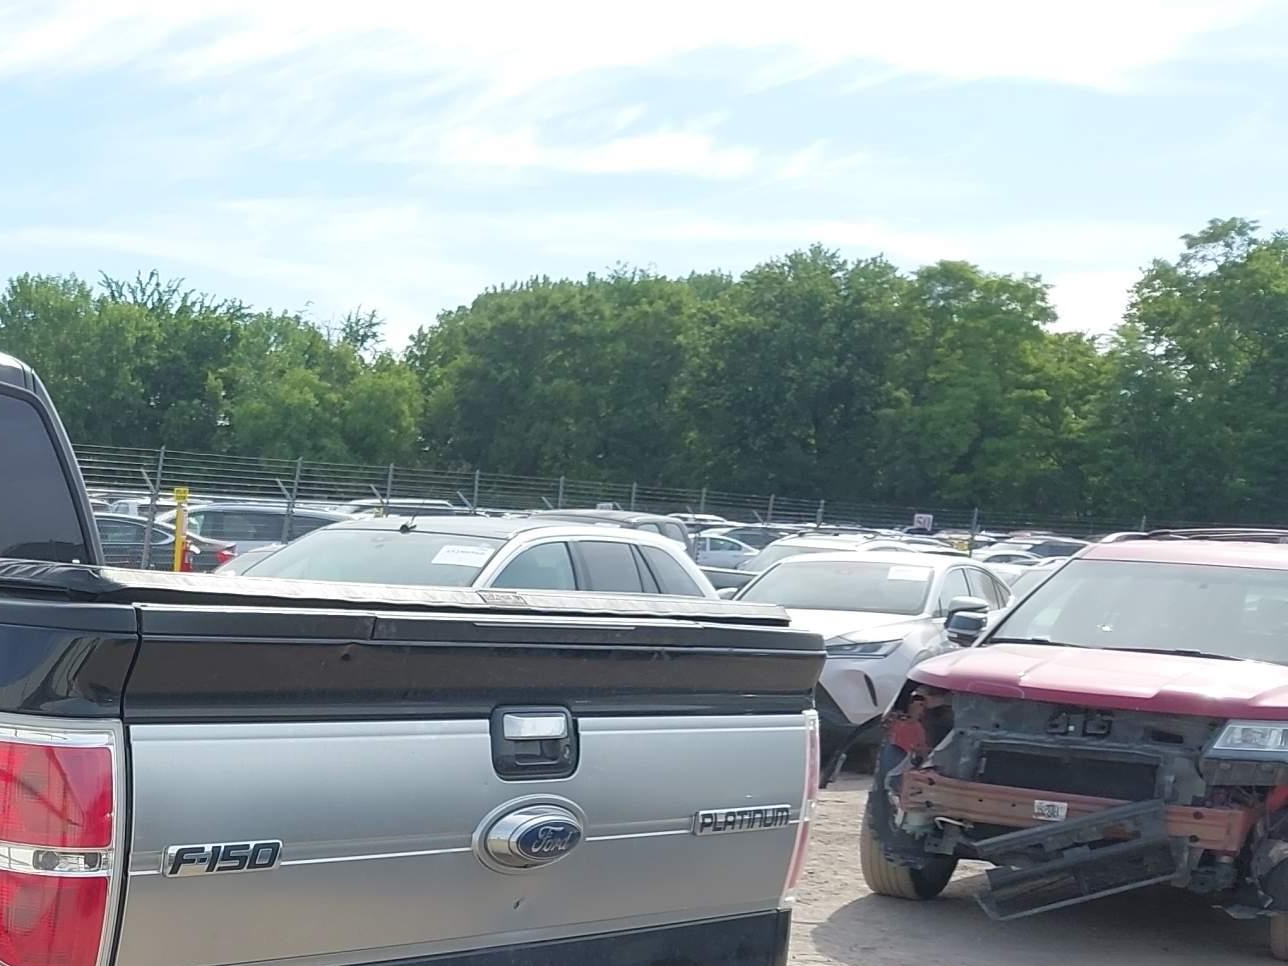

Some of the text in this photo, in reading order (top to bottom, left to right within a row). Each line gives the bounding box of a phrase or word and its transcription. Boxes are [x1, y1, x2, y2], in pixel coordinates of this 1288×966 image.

[699, 807, 790, 833] PLATINUM
[531, 825, 573, 853] Ford
[168, 841, 281, 875] F-150
